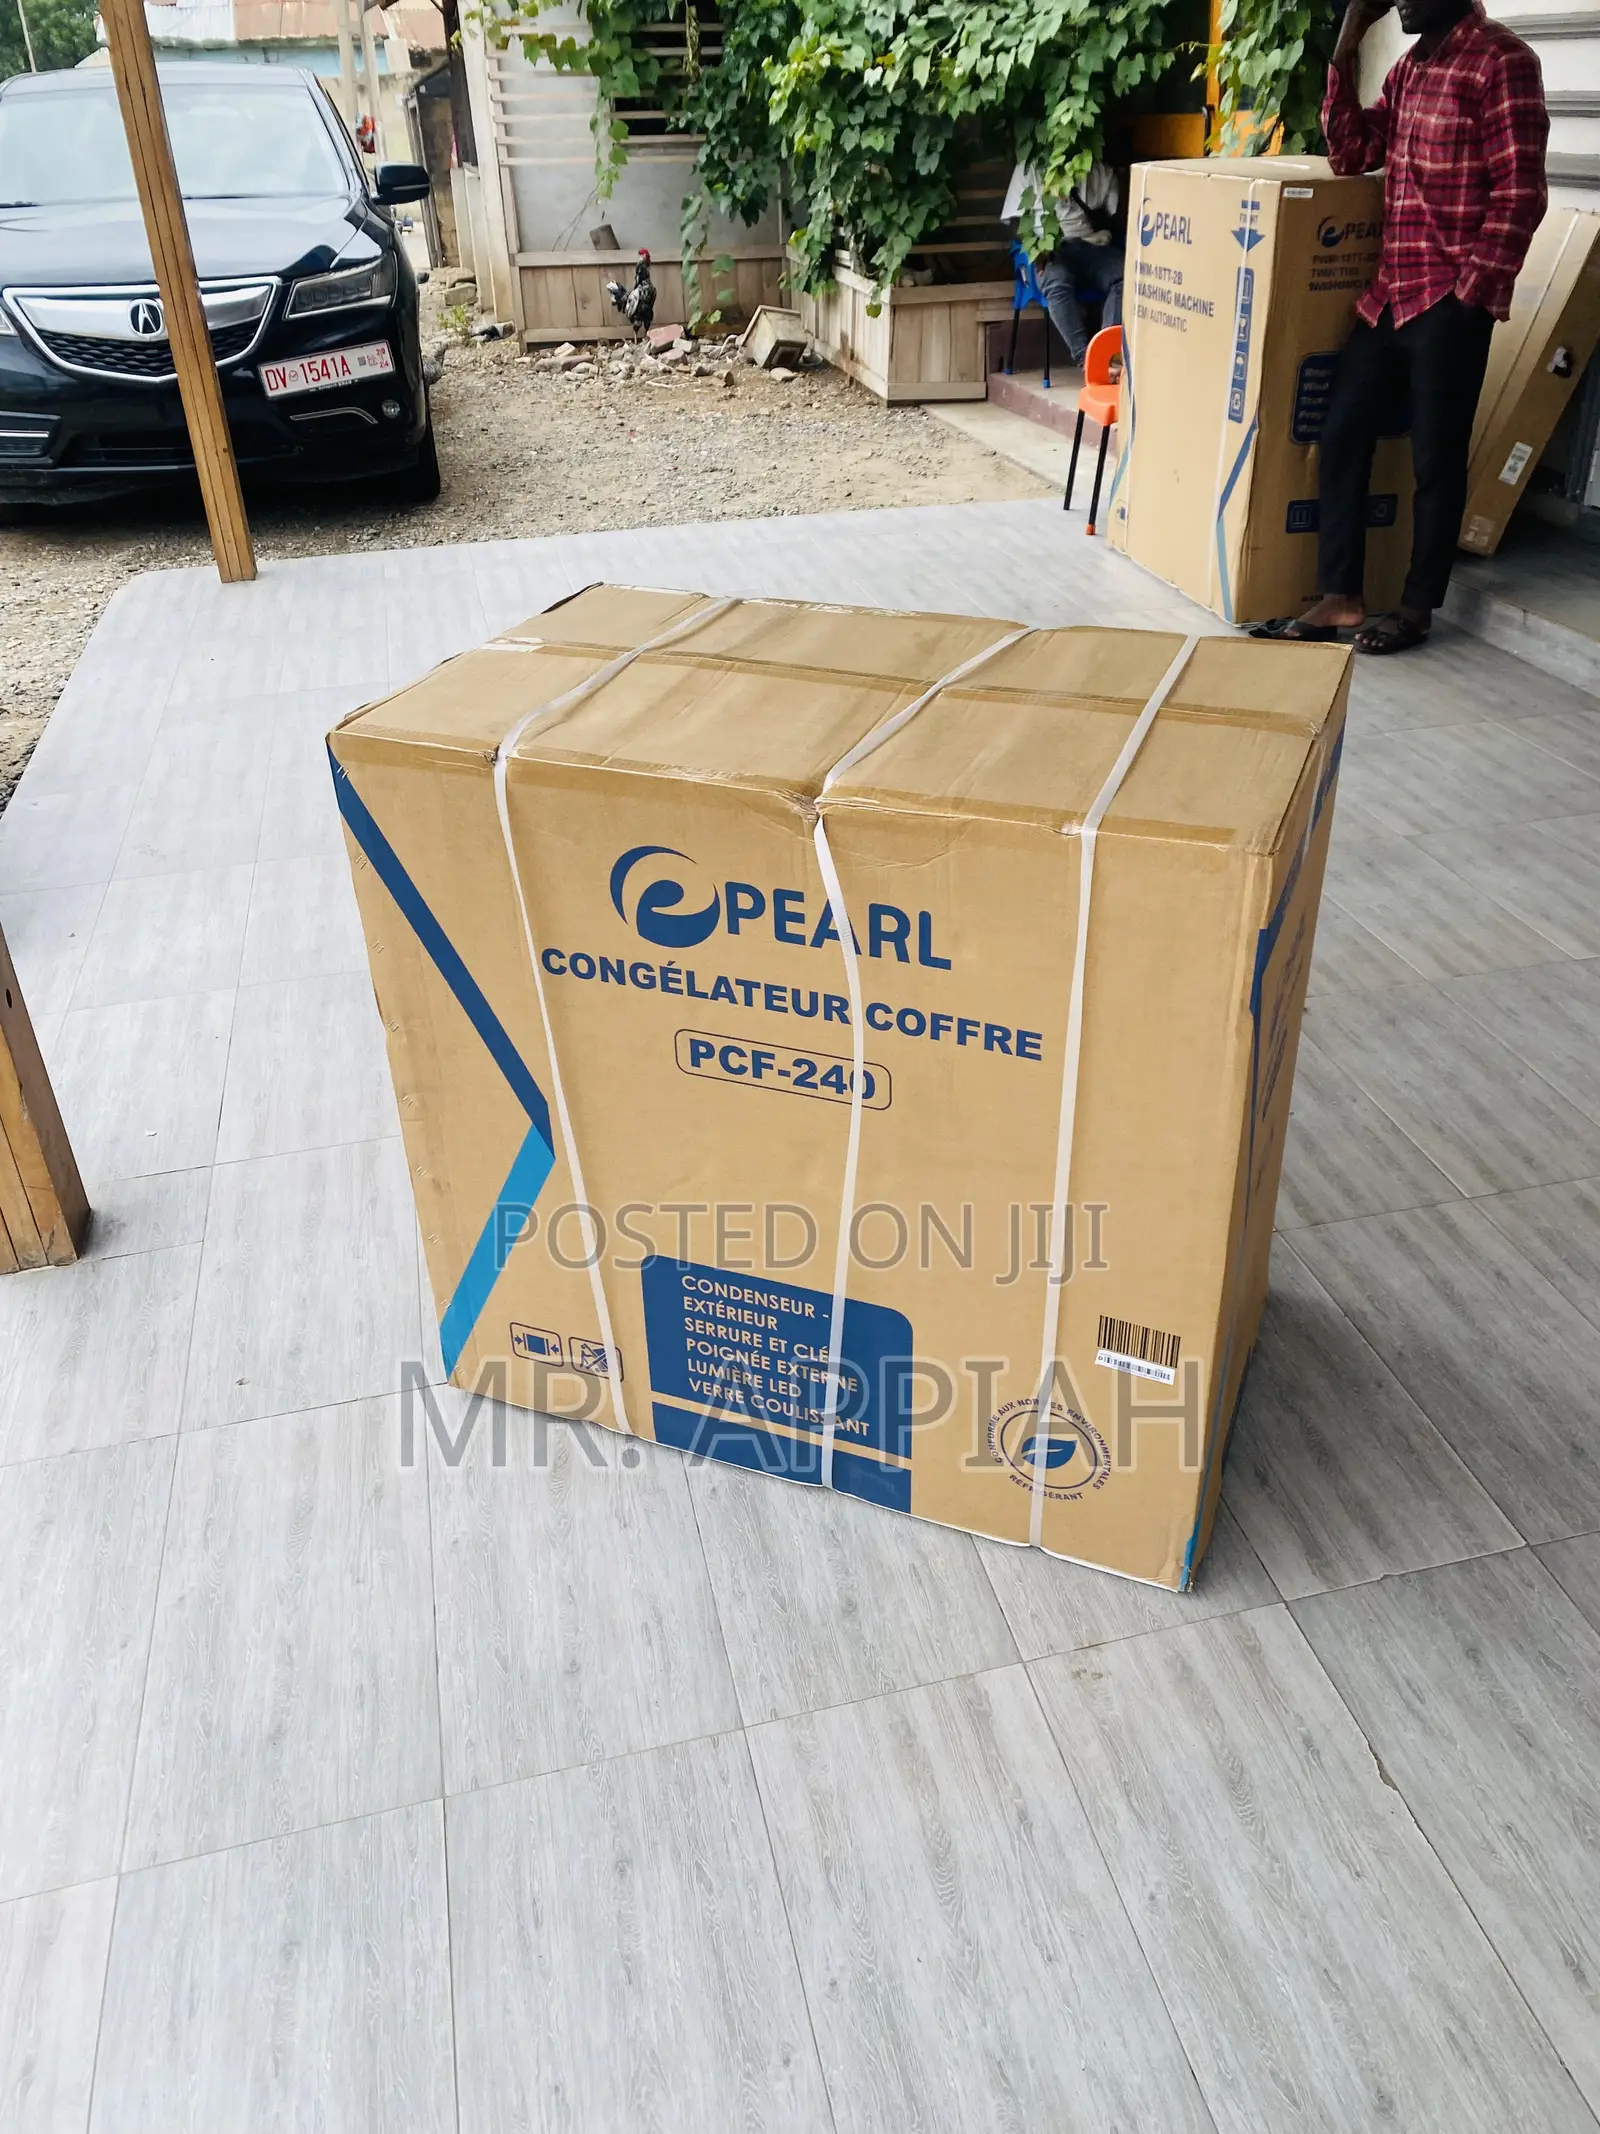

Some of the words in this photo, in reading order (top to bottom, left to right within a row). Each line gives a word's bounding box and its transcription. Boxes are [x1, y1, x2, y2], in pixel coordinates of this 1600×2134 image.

[1156, 212, 1192, 245] PEARL
[1150, 309, 1187, 332] AUTOMATIC
[1174, 294, 1214, 317] MACHINE
[265, 367, 287, 391] DV
[299, 355, 352, 384] 1541A
[725, 881, 952, 971] PEARL
[541, 947, 852, 1025] CONGÉLATEUR
[865, 1002, 1043, 1062] COFFRE
[689, 1037, 876, 1100] PCF-240
[681, 1275, 815, 1319] CONDENSEUR
[683, 1296, 778, 1331] EXTÉRIEUR
[684, 1316, 763, 1348] SERRURE
[769, 1336, 787, 1354] ET
[793, 1342, 829, 1364] CLÉ
[686, 1337, 771, 1371] POIGNÉE
[687, 1357, 763, 1389] LUMIÈRE
[769, 1379, 802, 1398] LED
[688, 1377, 745, 1404] VERRE
[997, 1402, 1016, 1417] AUX
[1017, 1398, 1064, 1411] NORES
